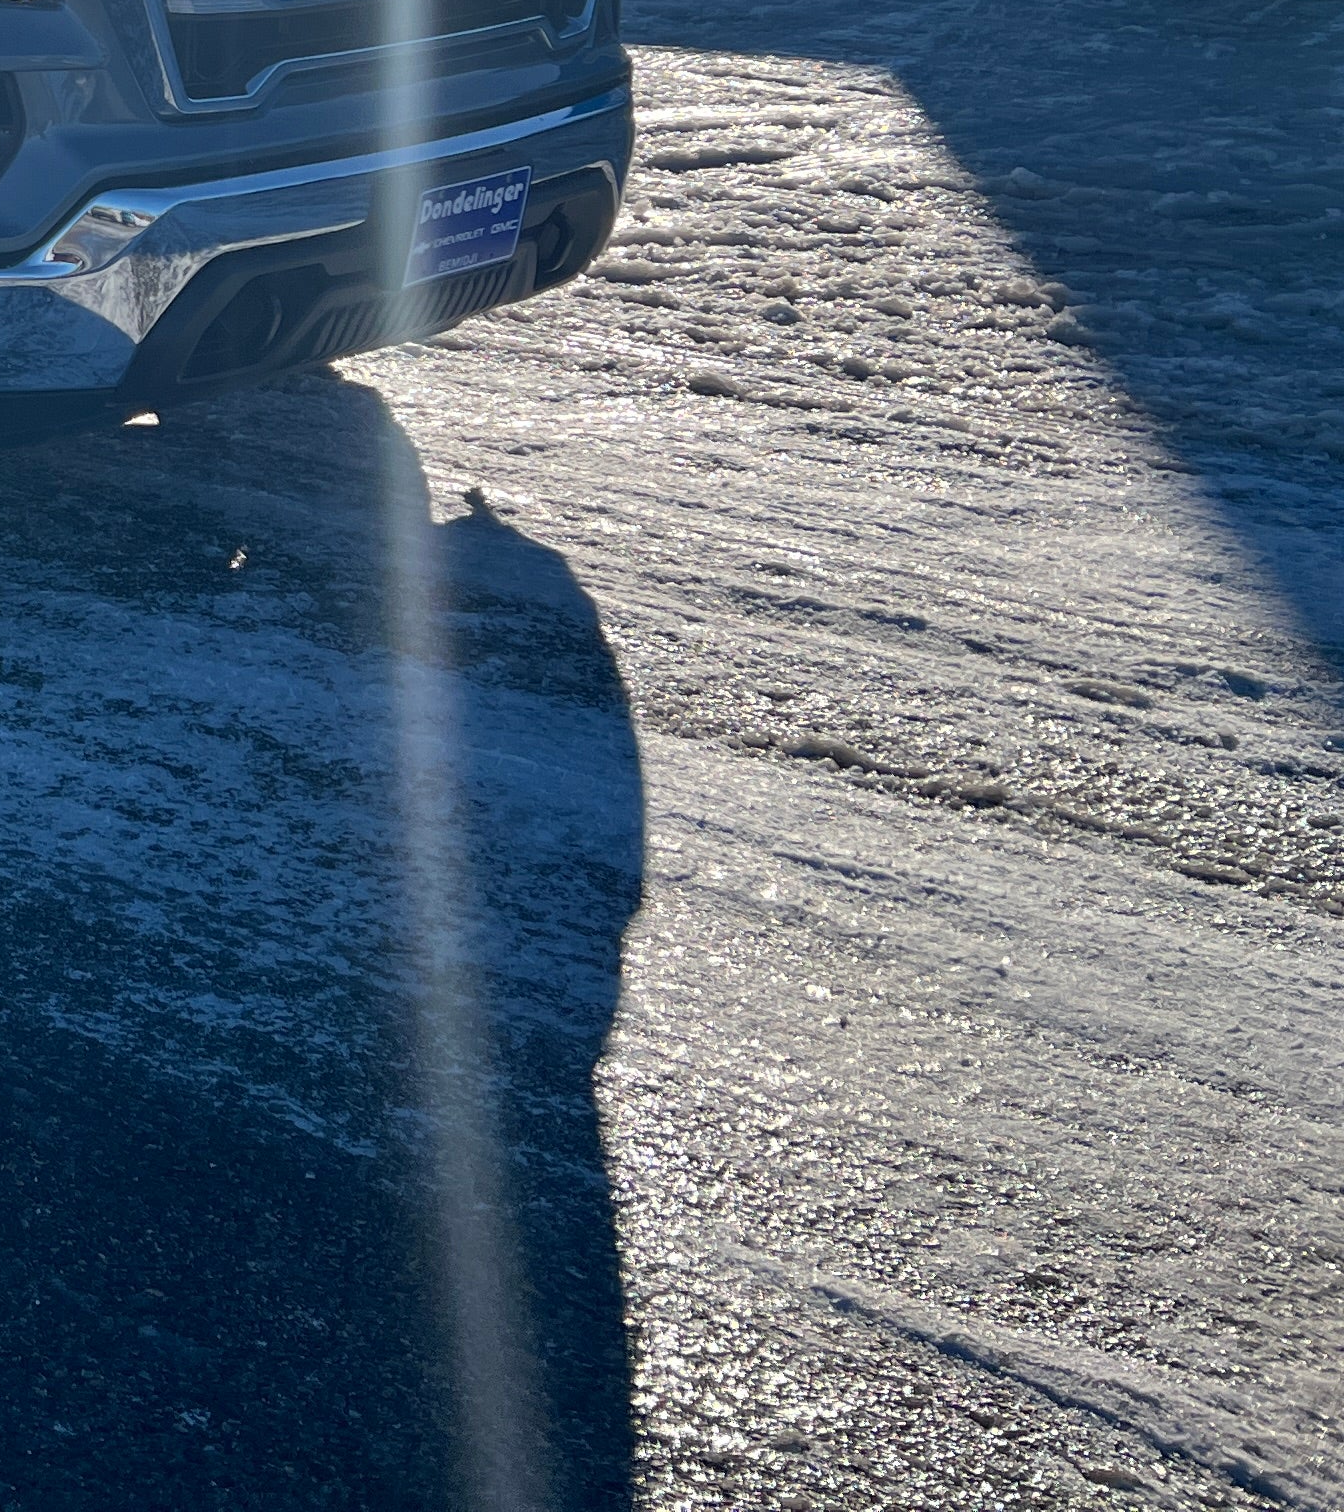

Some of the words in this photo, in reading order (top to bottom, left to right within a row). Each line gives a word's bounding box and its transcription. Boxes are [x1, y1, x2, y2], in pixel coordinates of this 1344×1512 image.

[419, 182, 524, 225] Dondelinger
[433, 227, 486, 249] CHEVROLET
[490, 218, 520, 235] GMC
[438, 252, 480, 272] BEMIDJI
